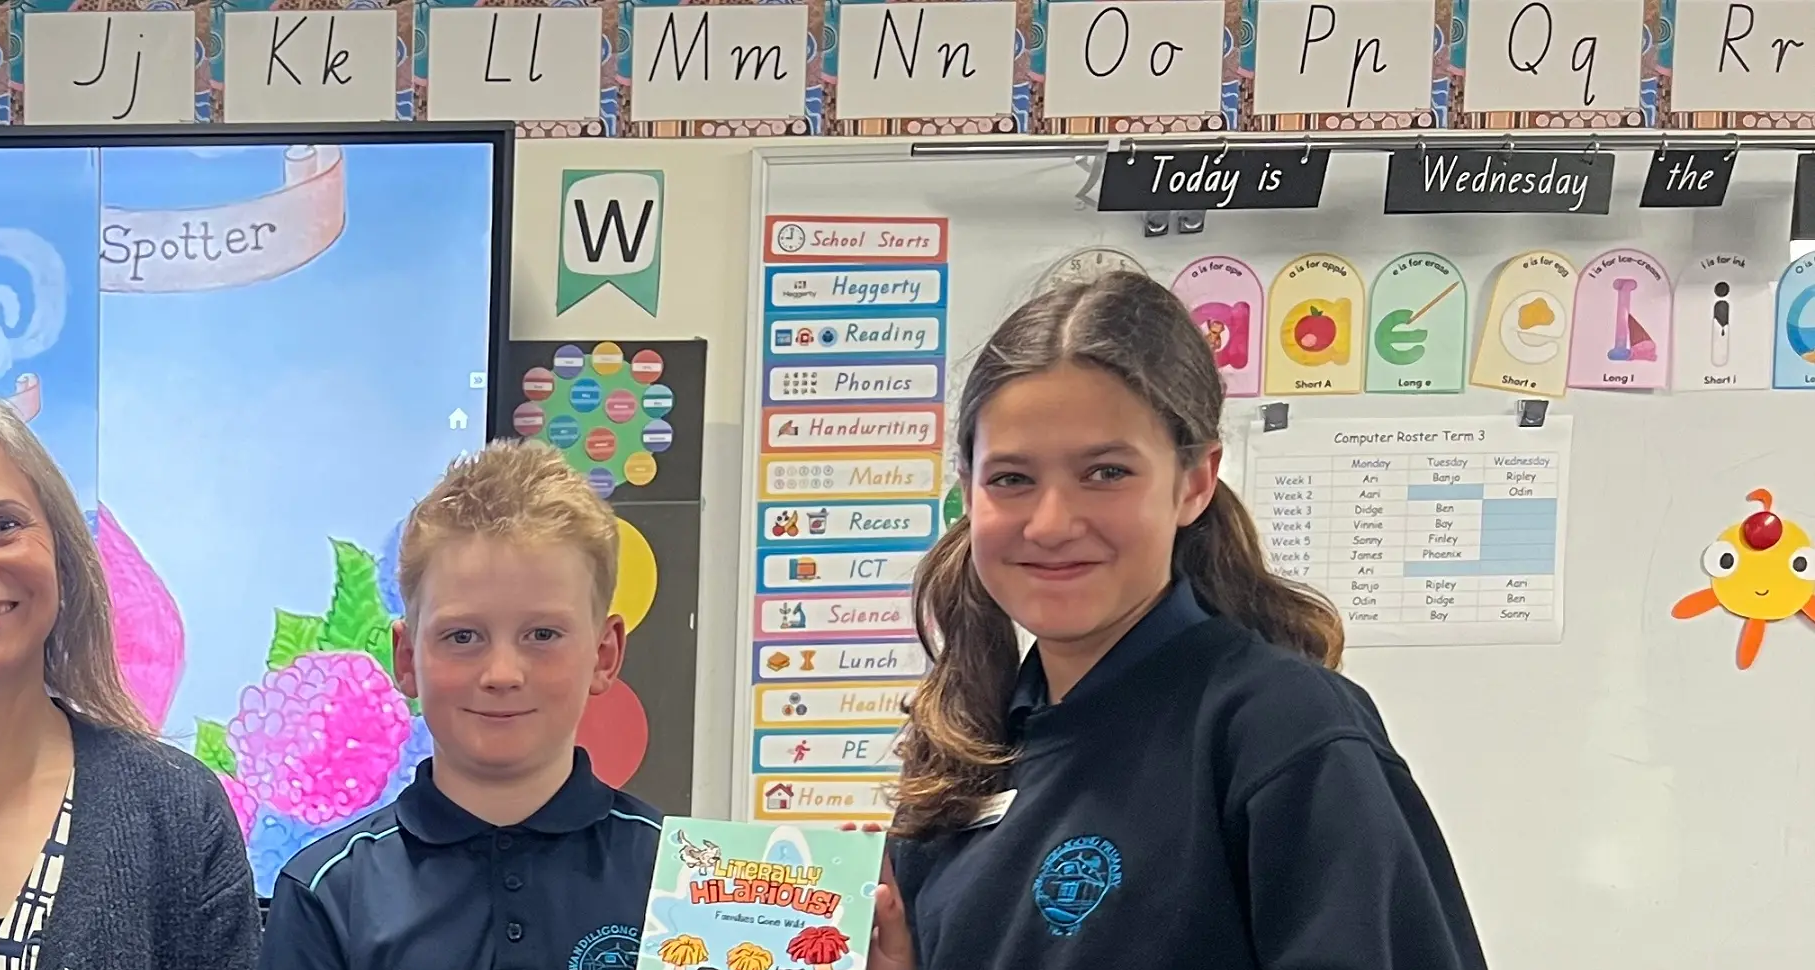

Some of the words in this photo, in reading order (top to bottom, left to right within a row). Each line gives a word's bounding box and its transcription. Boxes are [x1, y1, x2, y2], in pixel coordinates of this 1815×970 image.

[1665, 155, 1715, 192] the
[1151, 155, 1239, 208] Today
[1257, 162, 1282, 191] is
[1423, 154, 1589, 212] Wednesday
[574, 199, 654, 262] W
[810, 230, 865, 248] School
[878, 231, 930, 248] Starts
[100, 221, 276, 281] Spotter
[1322, 260, 1347, 277] apple
[783, 290, 817, 299] Heggerty
[832, 275, 921, 304] Heggerty
[845, 322, 926, 349] Reading
[835, 371, 912, 391] Phonics
[1295, 380, 1322, 389] Short
[1398, 378, 1423, 388] Long
[1501, 375, 1530, 388] Short
[1603, 373, 1629, 384] Long
[1704, 375, 1730, 385] Short
[809, 417, 929, 442] Handwriting
[1334, 432, 1394, 446] Computer
[1396, 430, 1438, 442] Roster
[1442, 430, 1474, 442] Term
[1478, 429, 1486, 441] 3
[1351, 458, 1391, 470] Monday
[1427, 457, 1468, 469] Tuesday
[1494, 456, 1550, 468] Wednesday
[849, 466, 914, 485] Maths
[1275, 476, 1304, 485] Week
[1432, 472, 1461, 485] Banjo
[1506, 471, 1536, 483] Ripley
[1274, 491, 1305, 501] Week
[1509, 486, 1533, 496] Odin
[1273, 506, 1304, 516] Week
[1354, 505, 1384, 517] Didge
[1436, 503, 1454, 513] Ben
[849, 511, 910, 531] Recess
[1272, 522, 1302, 531] Week
[1272, 537, 1301, 546] Week
[1428, 534, 1458, 545] Finley
[1271, 552, 1301, 561] Week
[1350, 551, 1383, 560] James
[1422, 549, 1462, 559] Phoenix
[849, 558, 888, 579] ICT
[1425, 580, 1457, 592] Ripley
[1507, 594, 1526, 603] Ben
[827, 604, 900, 624] Science
[839, 649, 897, 669] Lunch
[842, 740, 870, 760] PE
[798, 787, 855, 806] Home
[715, 910, 755, 925] Families
[757, 914, 781, 927] Gone
[784, 917, 806, 929] Wild
